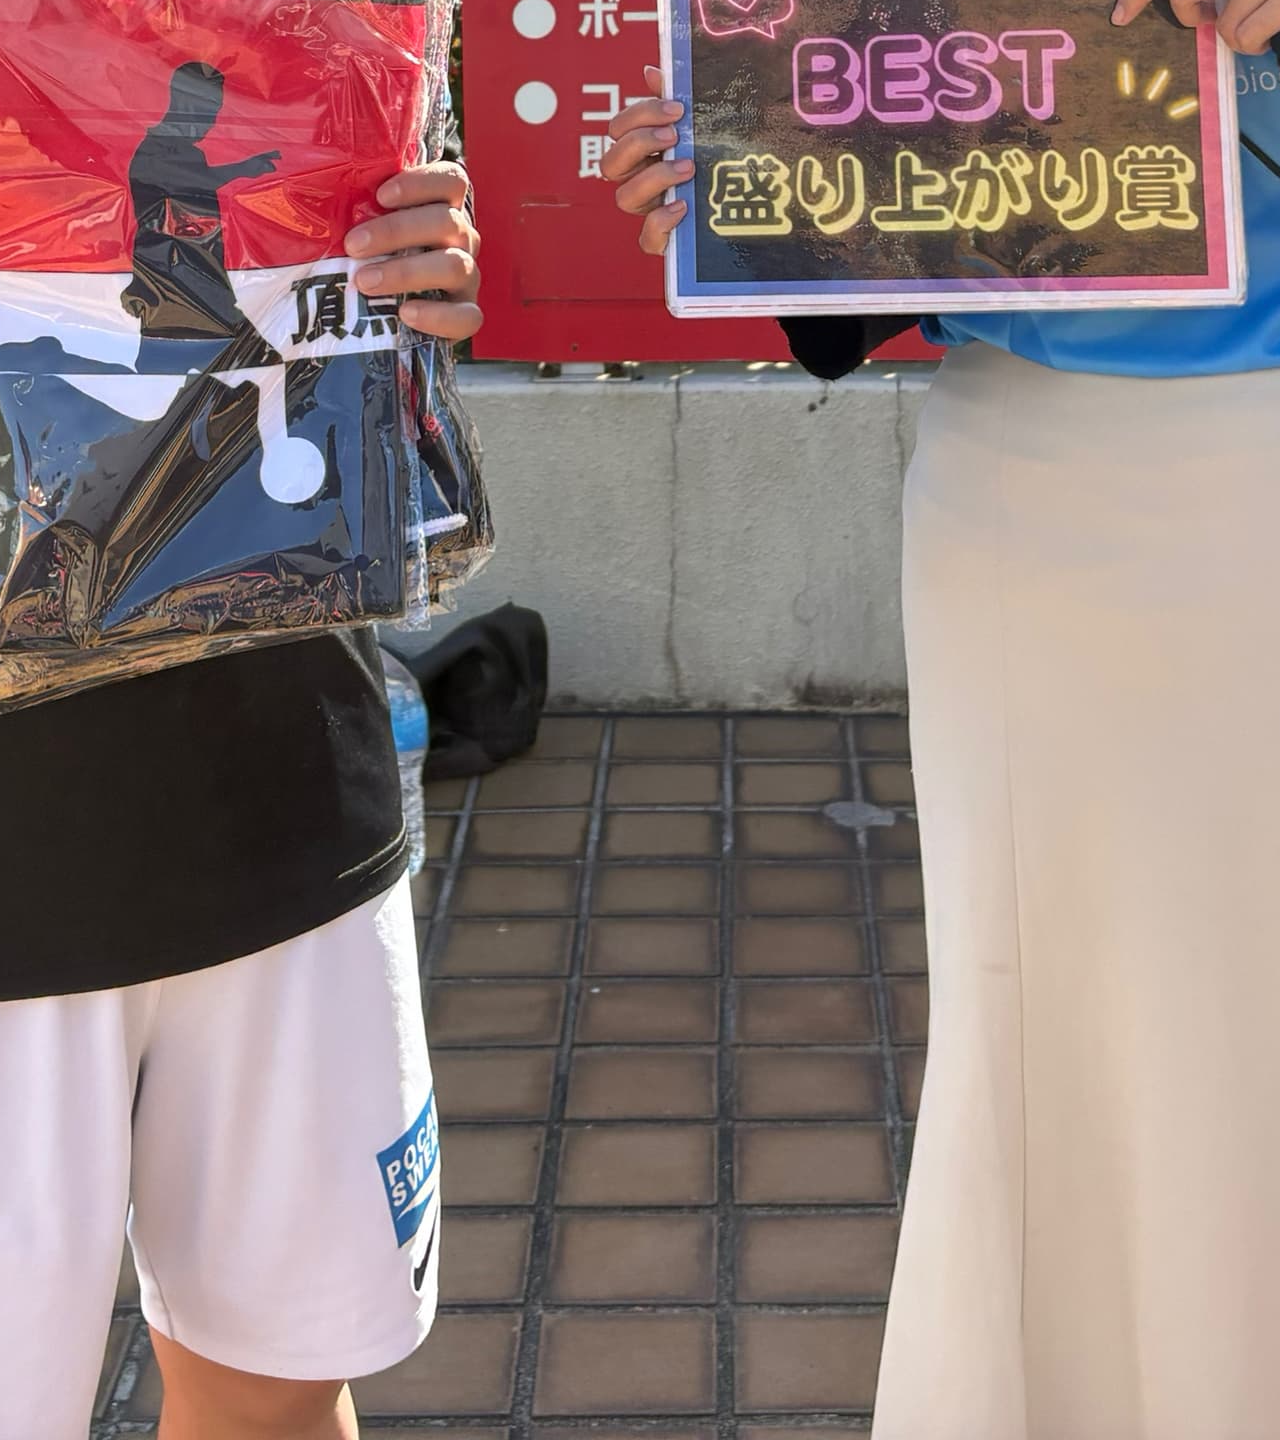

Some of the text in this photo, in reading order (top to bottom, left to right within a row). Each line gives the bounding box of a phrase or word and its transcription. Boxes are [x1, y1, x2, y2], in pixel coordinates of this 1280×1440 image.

[791, 28, 1077, 126] BEST
[708, 145, 1200, 236] 盛り上がり賞
